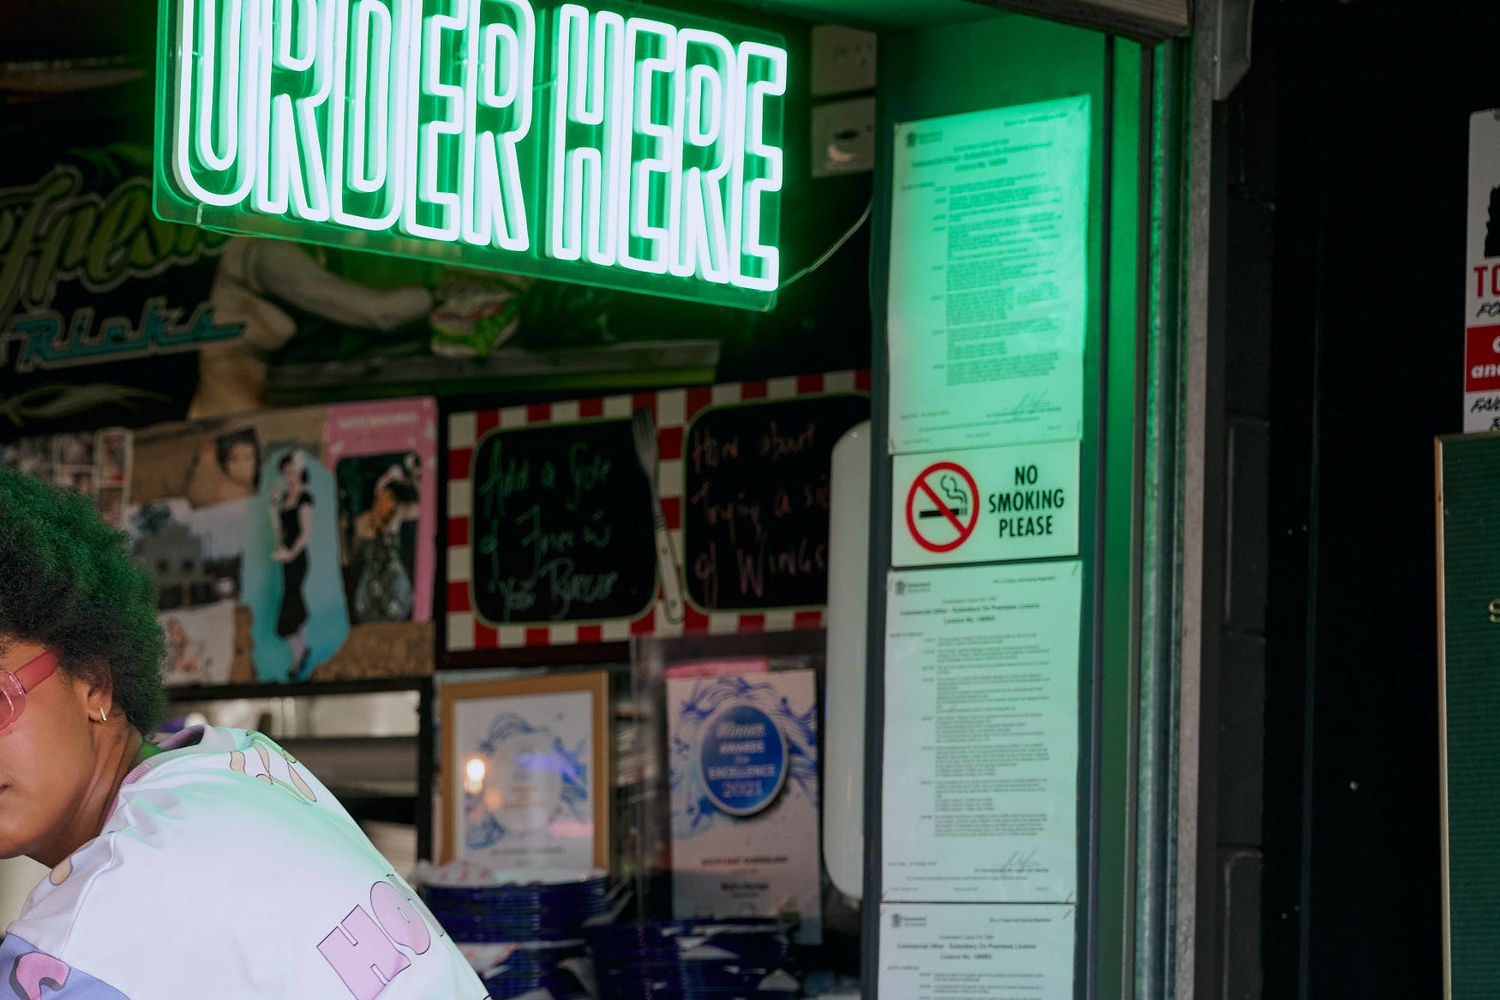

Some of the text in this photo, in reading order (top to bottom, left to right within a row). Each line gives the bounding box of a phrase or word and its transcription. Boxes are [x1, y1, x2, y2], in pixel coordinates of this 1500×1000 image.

[546, 3, 789, 292] HERE
[1014, 464, 1038, 486] NO
[988, 489, 1065, 514] SMOKING
[999, 515, 1054, 539] PLEASE
